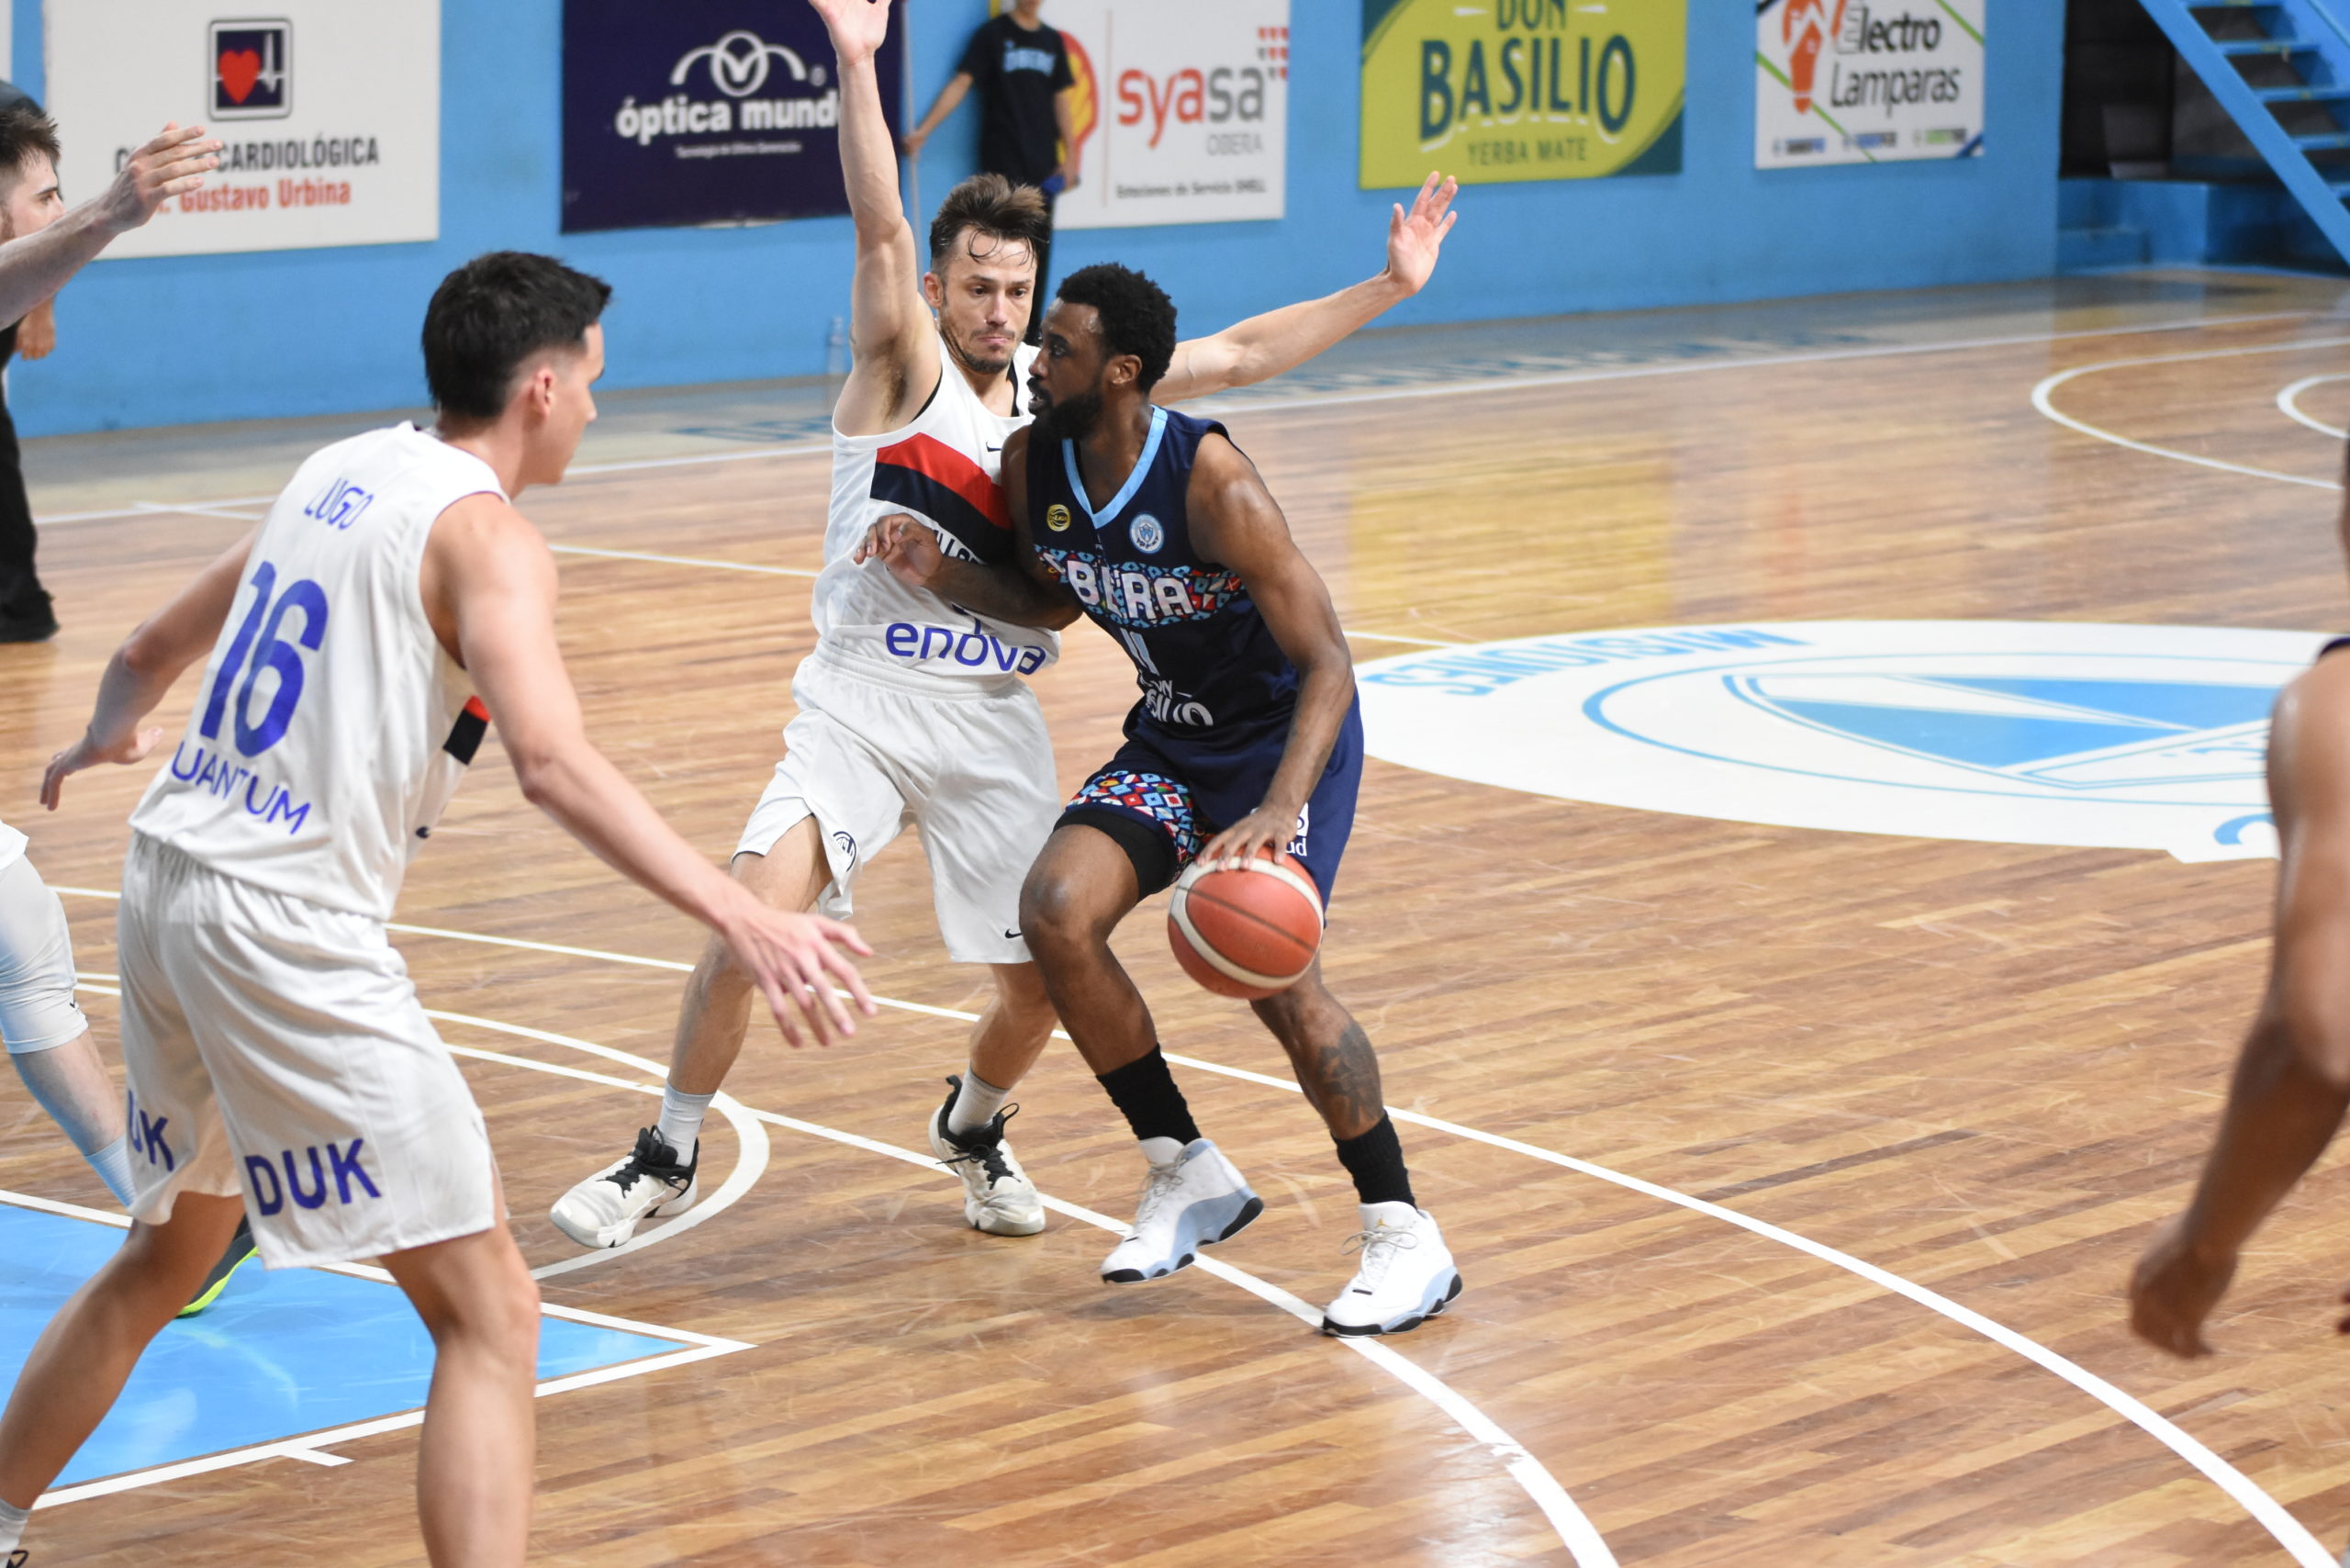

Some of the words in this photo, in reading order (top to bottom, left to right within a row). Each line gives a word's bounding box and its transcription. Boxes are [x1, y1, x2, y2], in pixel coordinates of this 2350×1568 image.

[615, 96, 732, 145] óptica
[741, 90, 840, 129] mund
[1117, 67, 1264, 149] syasa
[1420, 33, 1636, 142] BASILIO
[179, 182, 269, 212] Gustavo
[278, 179, 351, 208] Urbina
[304, 476, 374, 530] LUGO
[199, 560, 328, 758] 16
[885, 622, 1046, 676] enova
[1360, 630, 1812, 696] MISIONES
[172, 741, 310, 835] UANTUM
[129, 1089, 174, 1172] UK
[244, 1137, 381, 1216] DUK
